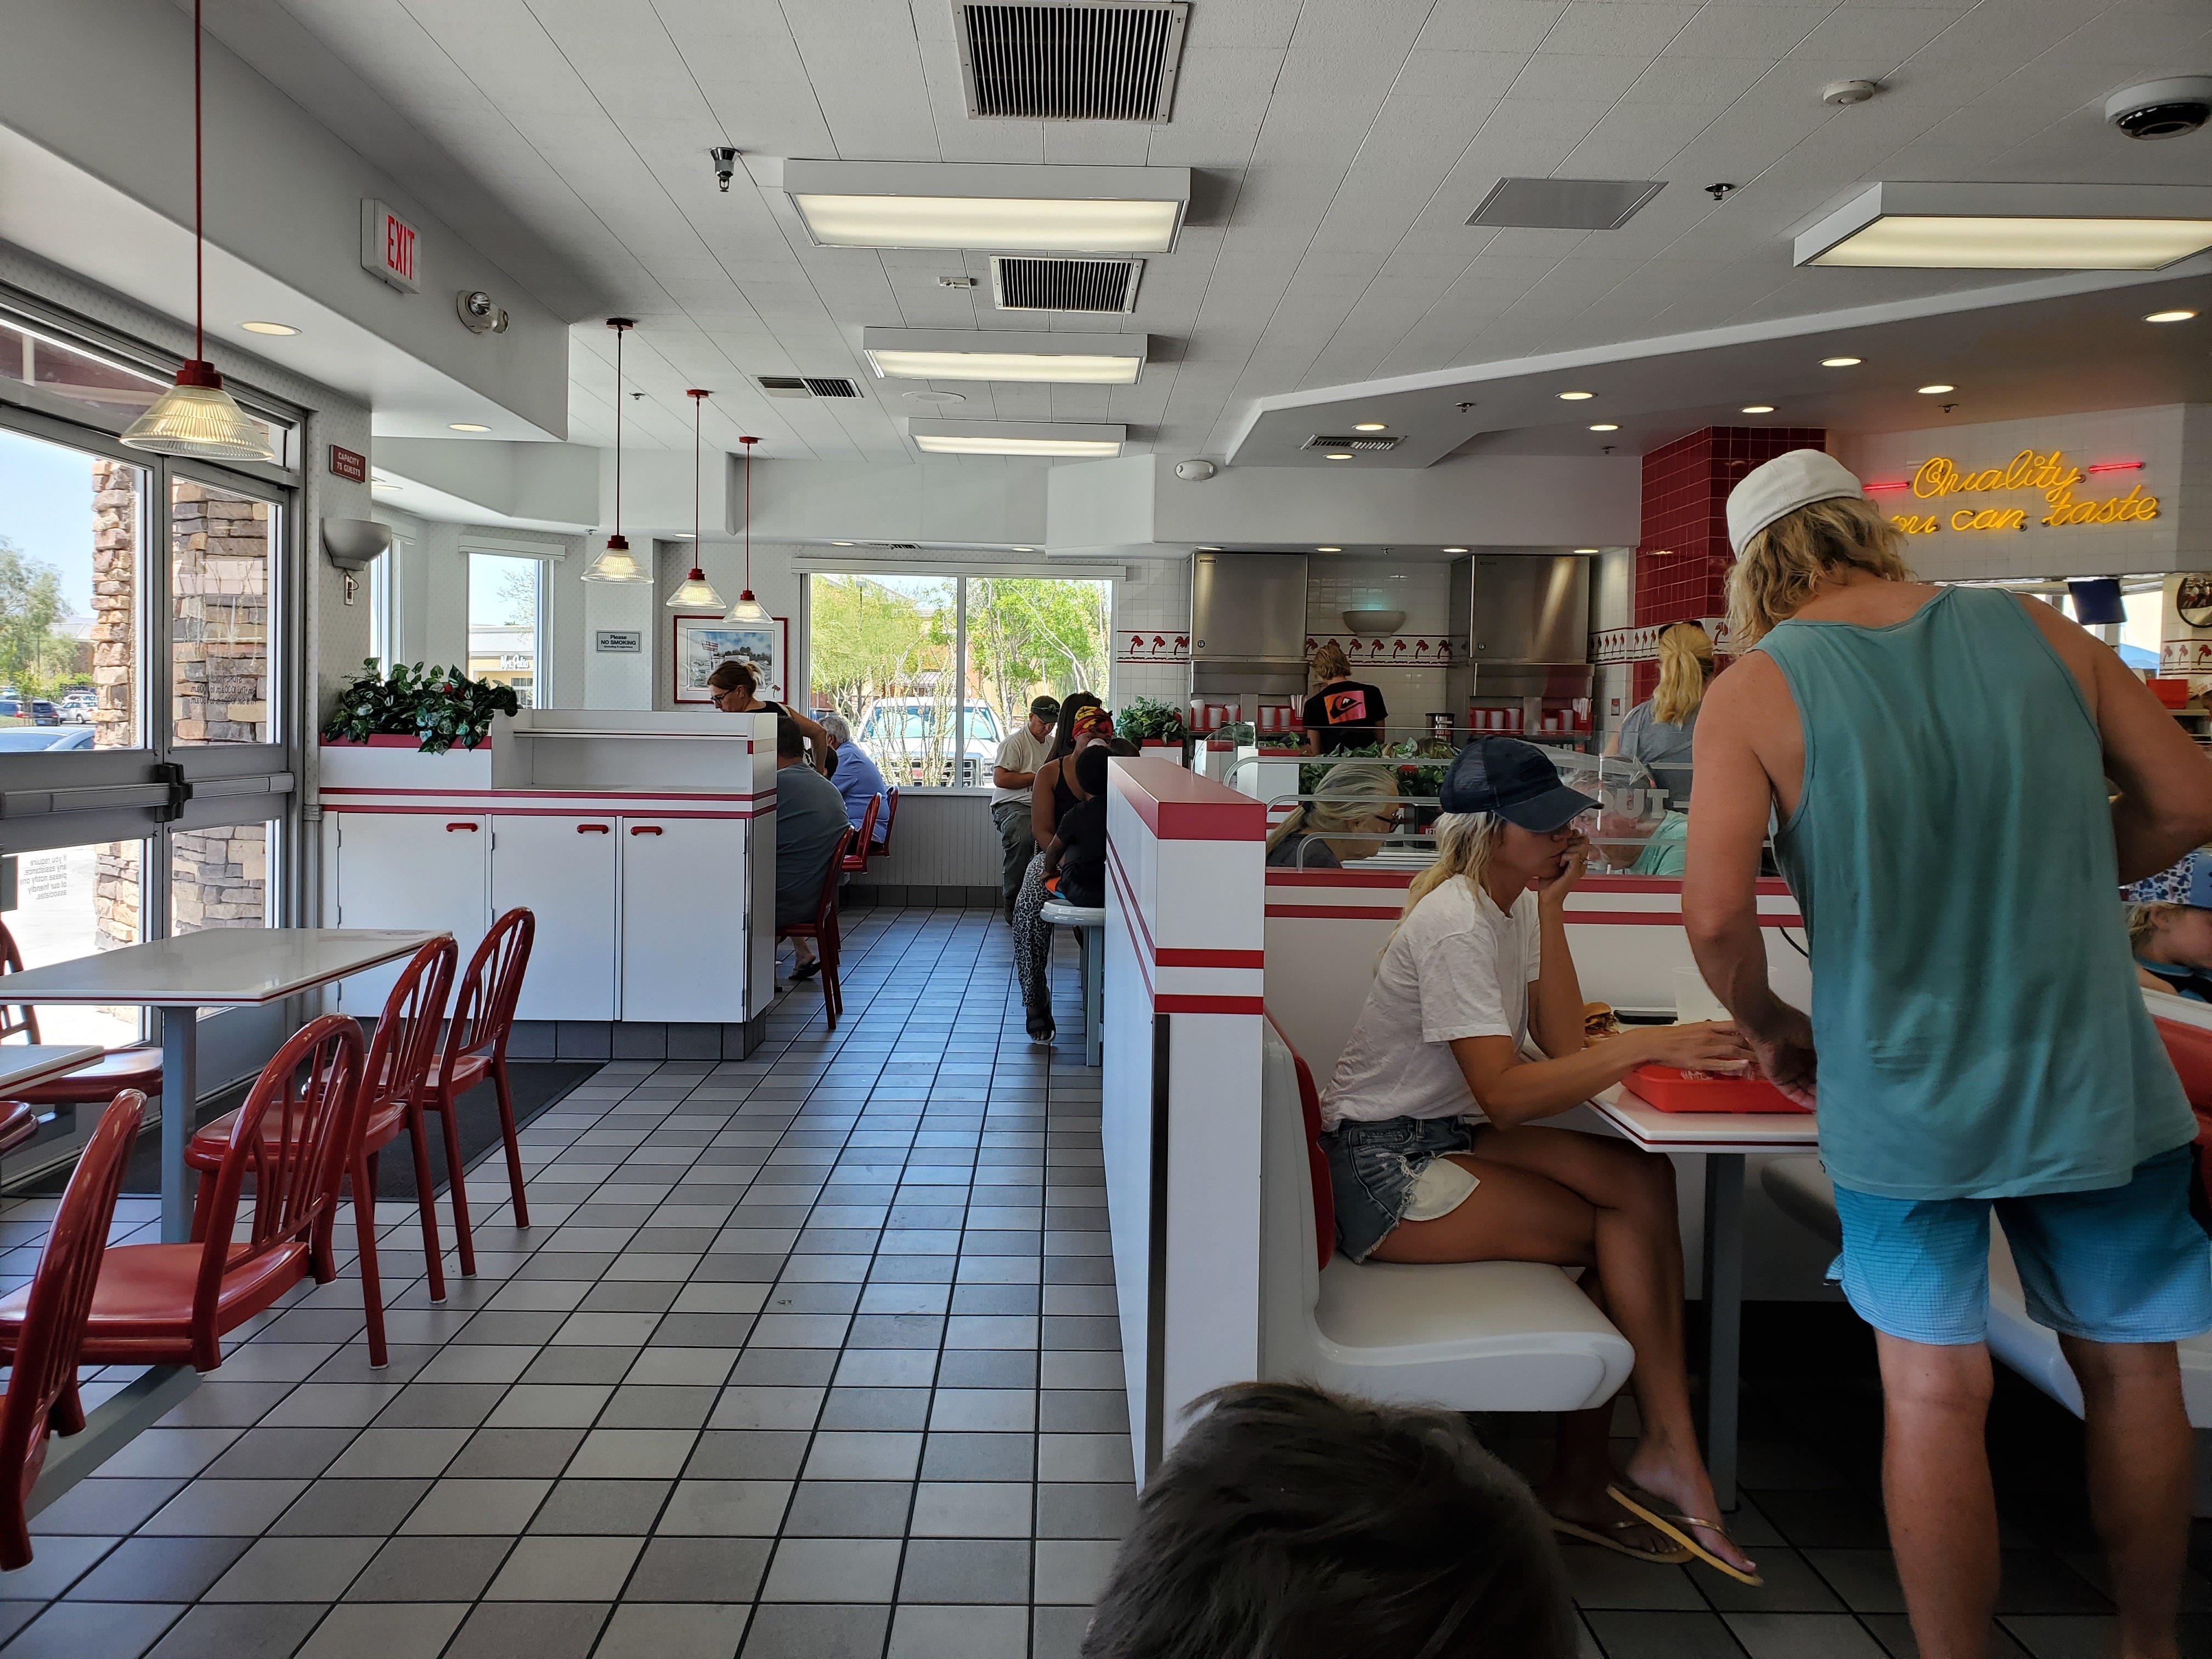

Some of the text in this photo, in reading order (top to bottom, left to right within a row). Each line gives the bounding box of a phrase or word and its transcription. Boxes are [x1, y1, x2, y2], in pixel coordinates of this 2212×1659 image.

[387, 215, 415, 280] EXIT
[336, 461, 360, 477] 75 GUESTS
[338, 452, 360, 466] CAPACITY
[1913, 449, 2083, 503] Quality
[1891, 484, 2158, 534] ou can taste
